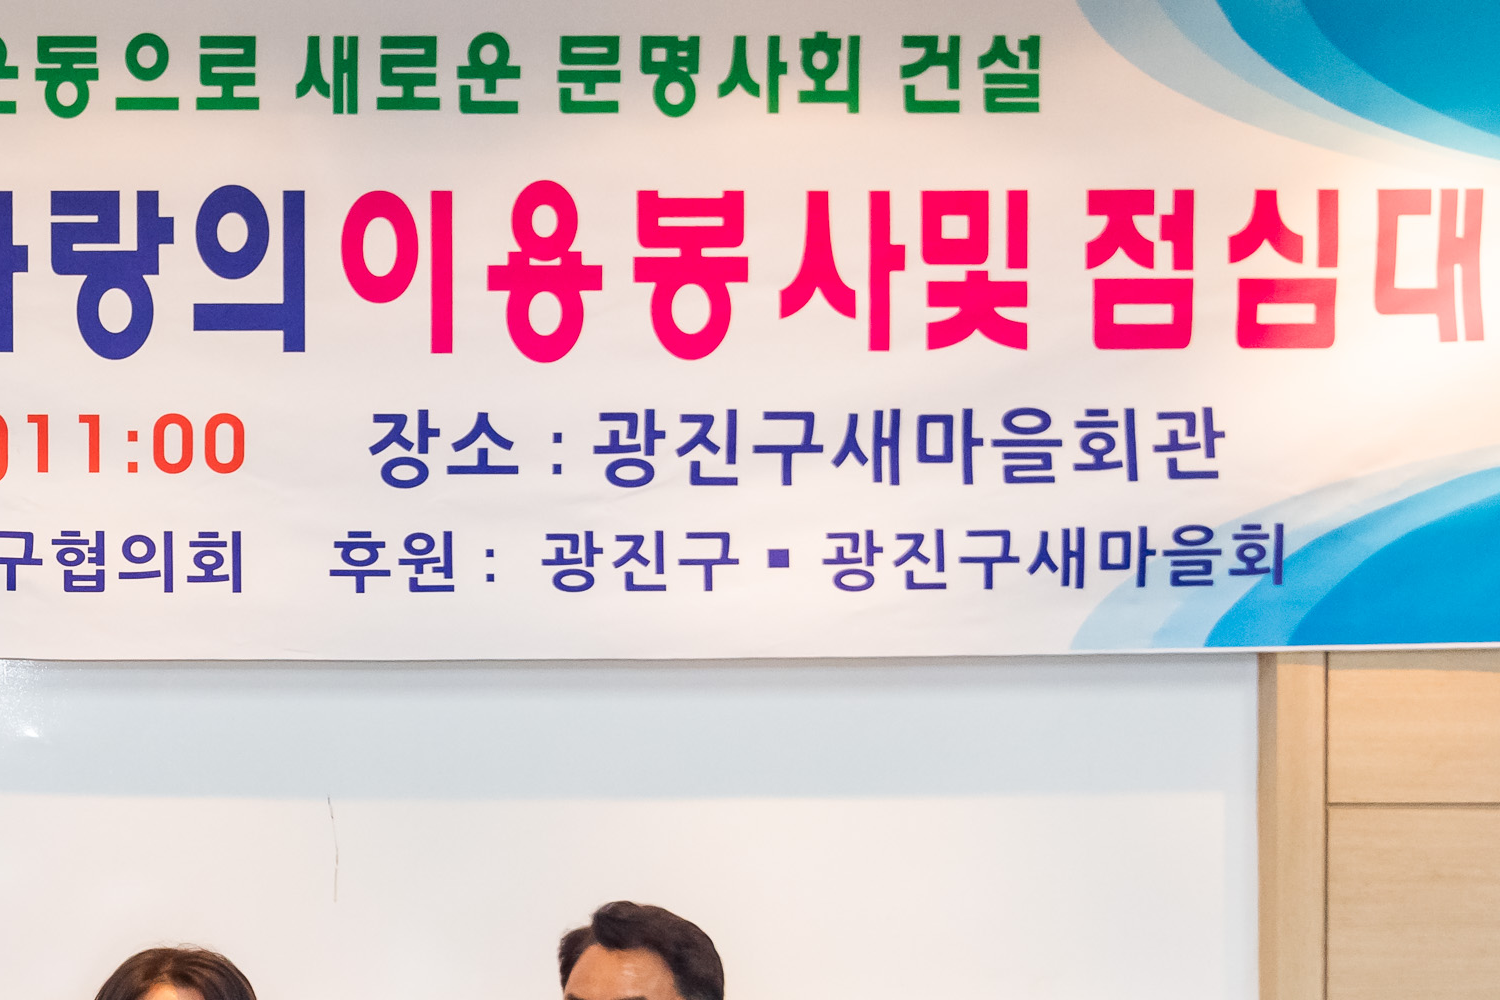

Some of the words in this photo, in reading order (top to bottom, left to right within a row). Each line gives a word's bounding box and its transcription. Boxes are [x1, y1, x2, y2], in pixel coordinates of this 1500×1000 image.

[295, 31, 521, 118] 새로운
[556, 31, 861, 118] 문명사회
[900, 31, 1041, 116] 건설
[593, 406, 1227, 489] 광진구새마을회관
[540, 529, 741, 593] 광진구
[821, 522, 1288, 594] 광진구새마을회
